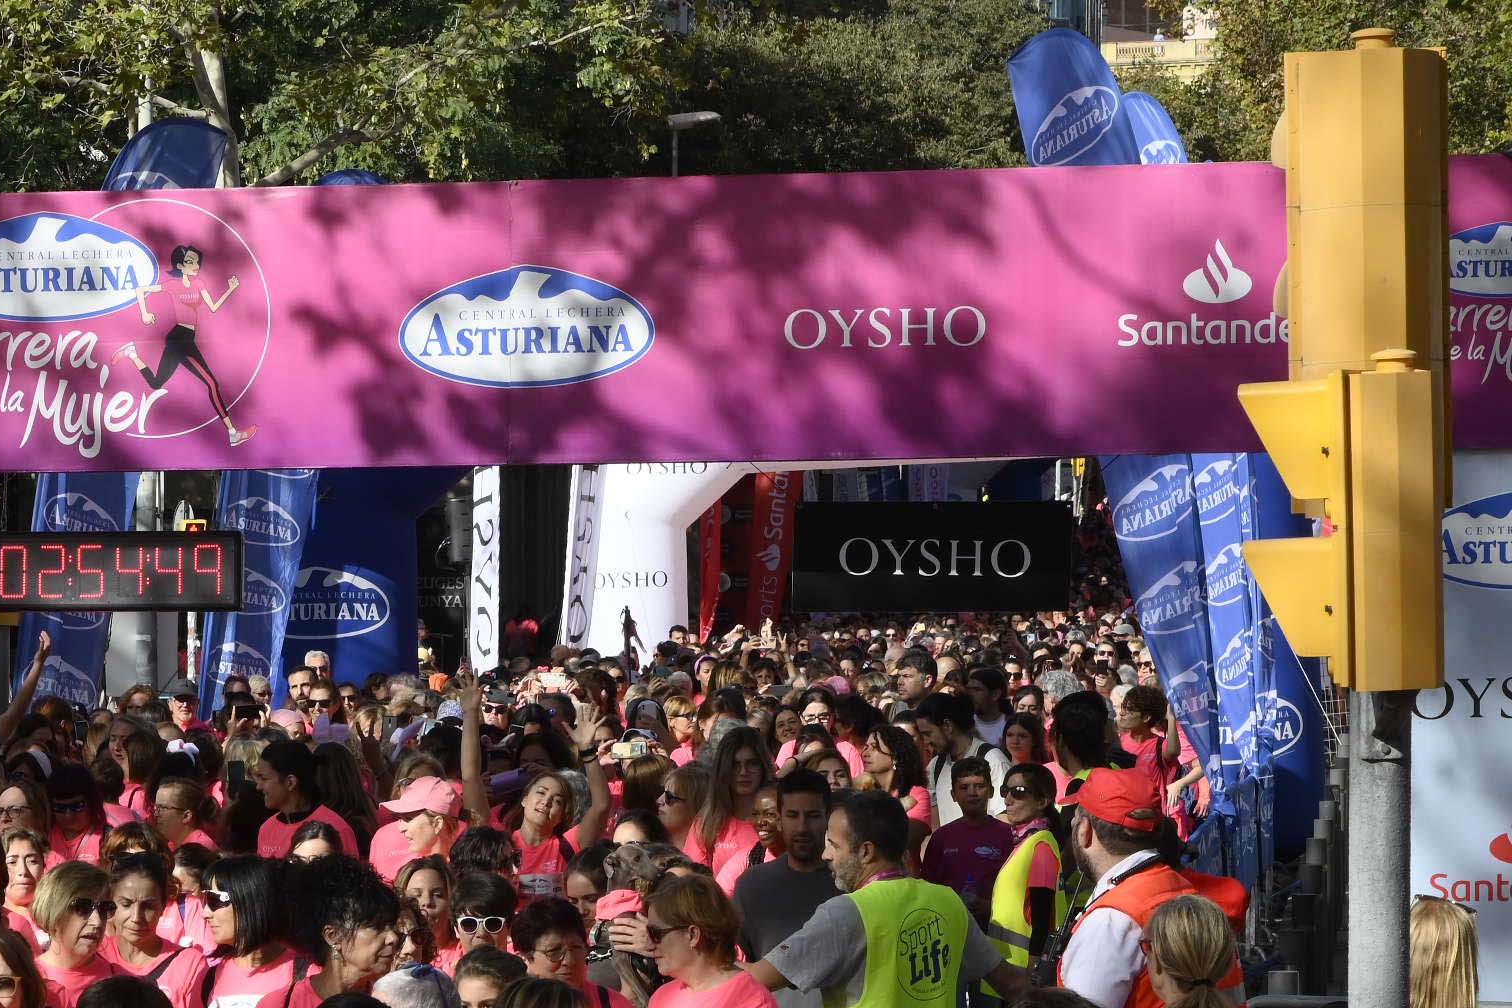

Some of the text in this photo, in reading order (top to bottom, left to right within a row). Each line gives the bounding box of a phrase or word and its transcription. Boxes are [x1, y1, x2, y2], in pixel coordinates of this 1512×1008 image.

[61, 248, 136, 260] LECHERA
[419, 311, 635, 358] ASTURIANA
[458, 306, 626, 321] CENTRAL LECHERA
[784, 305, 987, 350] OYSHO
[1467, 333, 1485, 361] la
[0, 372, 25, 413] la
[19, 363, 169, 459] Mujer
[0, 543, 223, 599] 02:54:49
[838, 536, 1032, 578] OYSHO
[592, 570, 668, 590] OYSHO
[899, 915, 944, 957] Sport
[908, 939, 950, 986] Life
